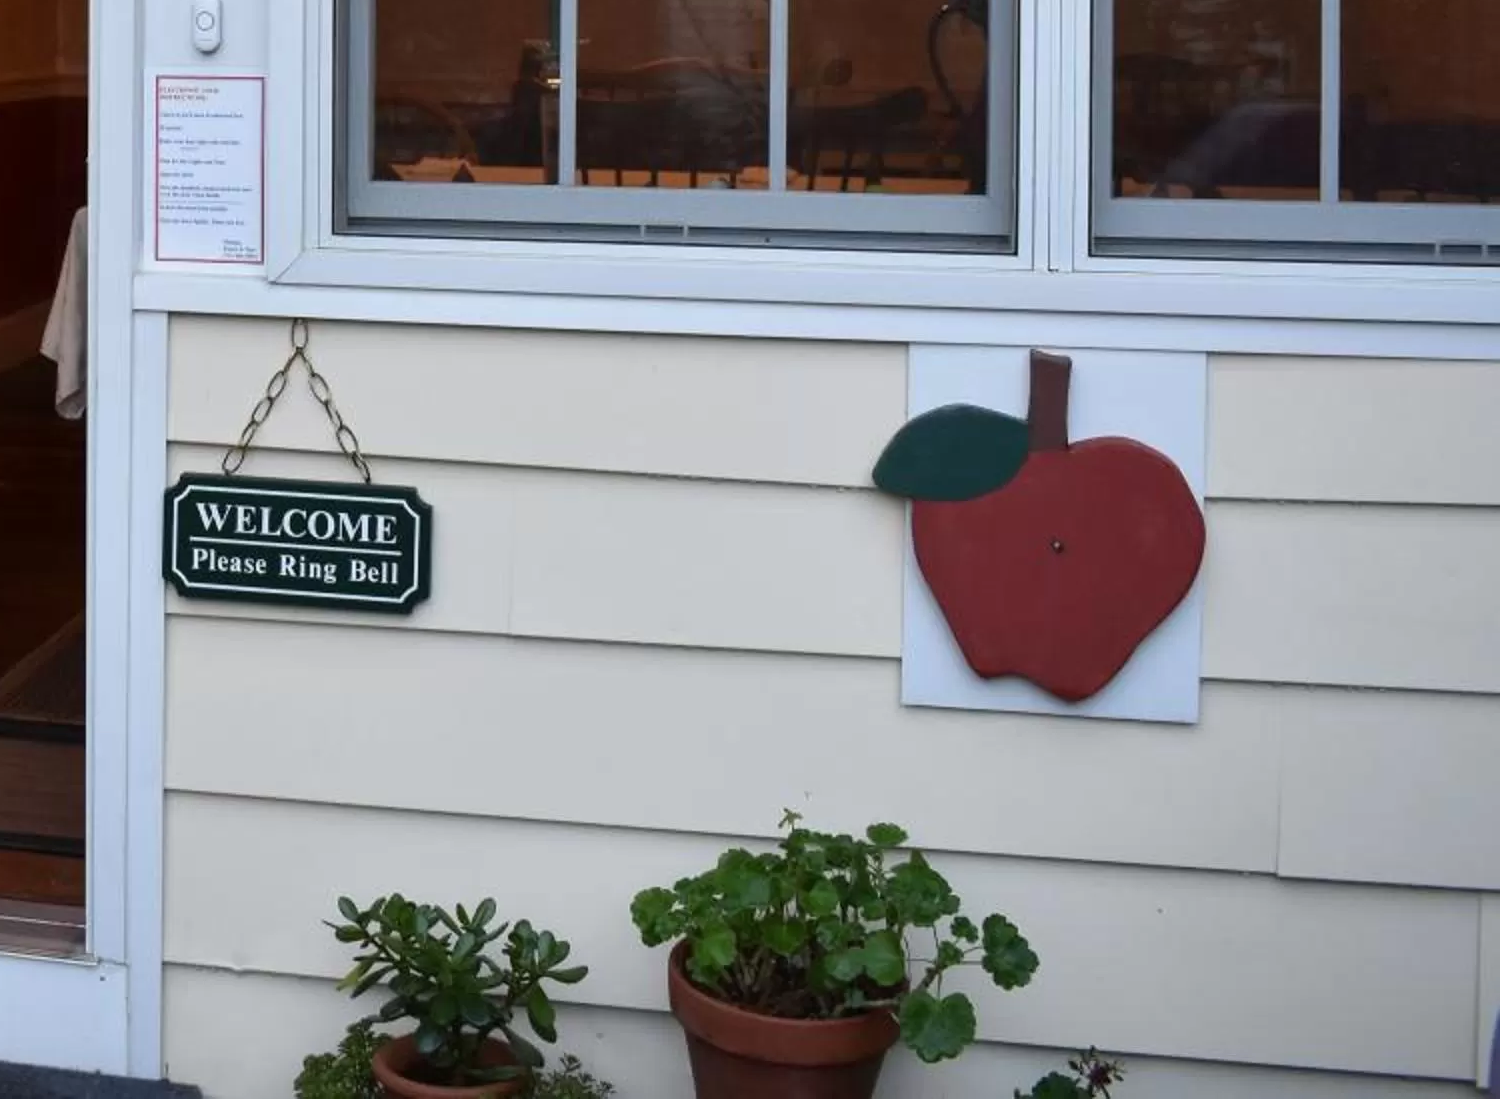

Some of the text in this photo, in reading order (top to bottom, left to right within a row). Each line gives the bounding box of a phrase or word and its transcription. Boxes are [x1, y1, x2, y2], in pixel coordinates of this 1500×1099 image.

[195, 502, 398, 544] WELCOME
[191, 547, 399, 584] Please Ring Bell
